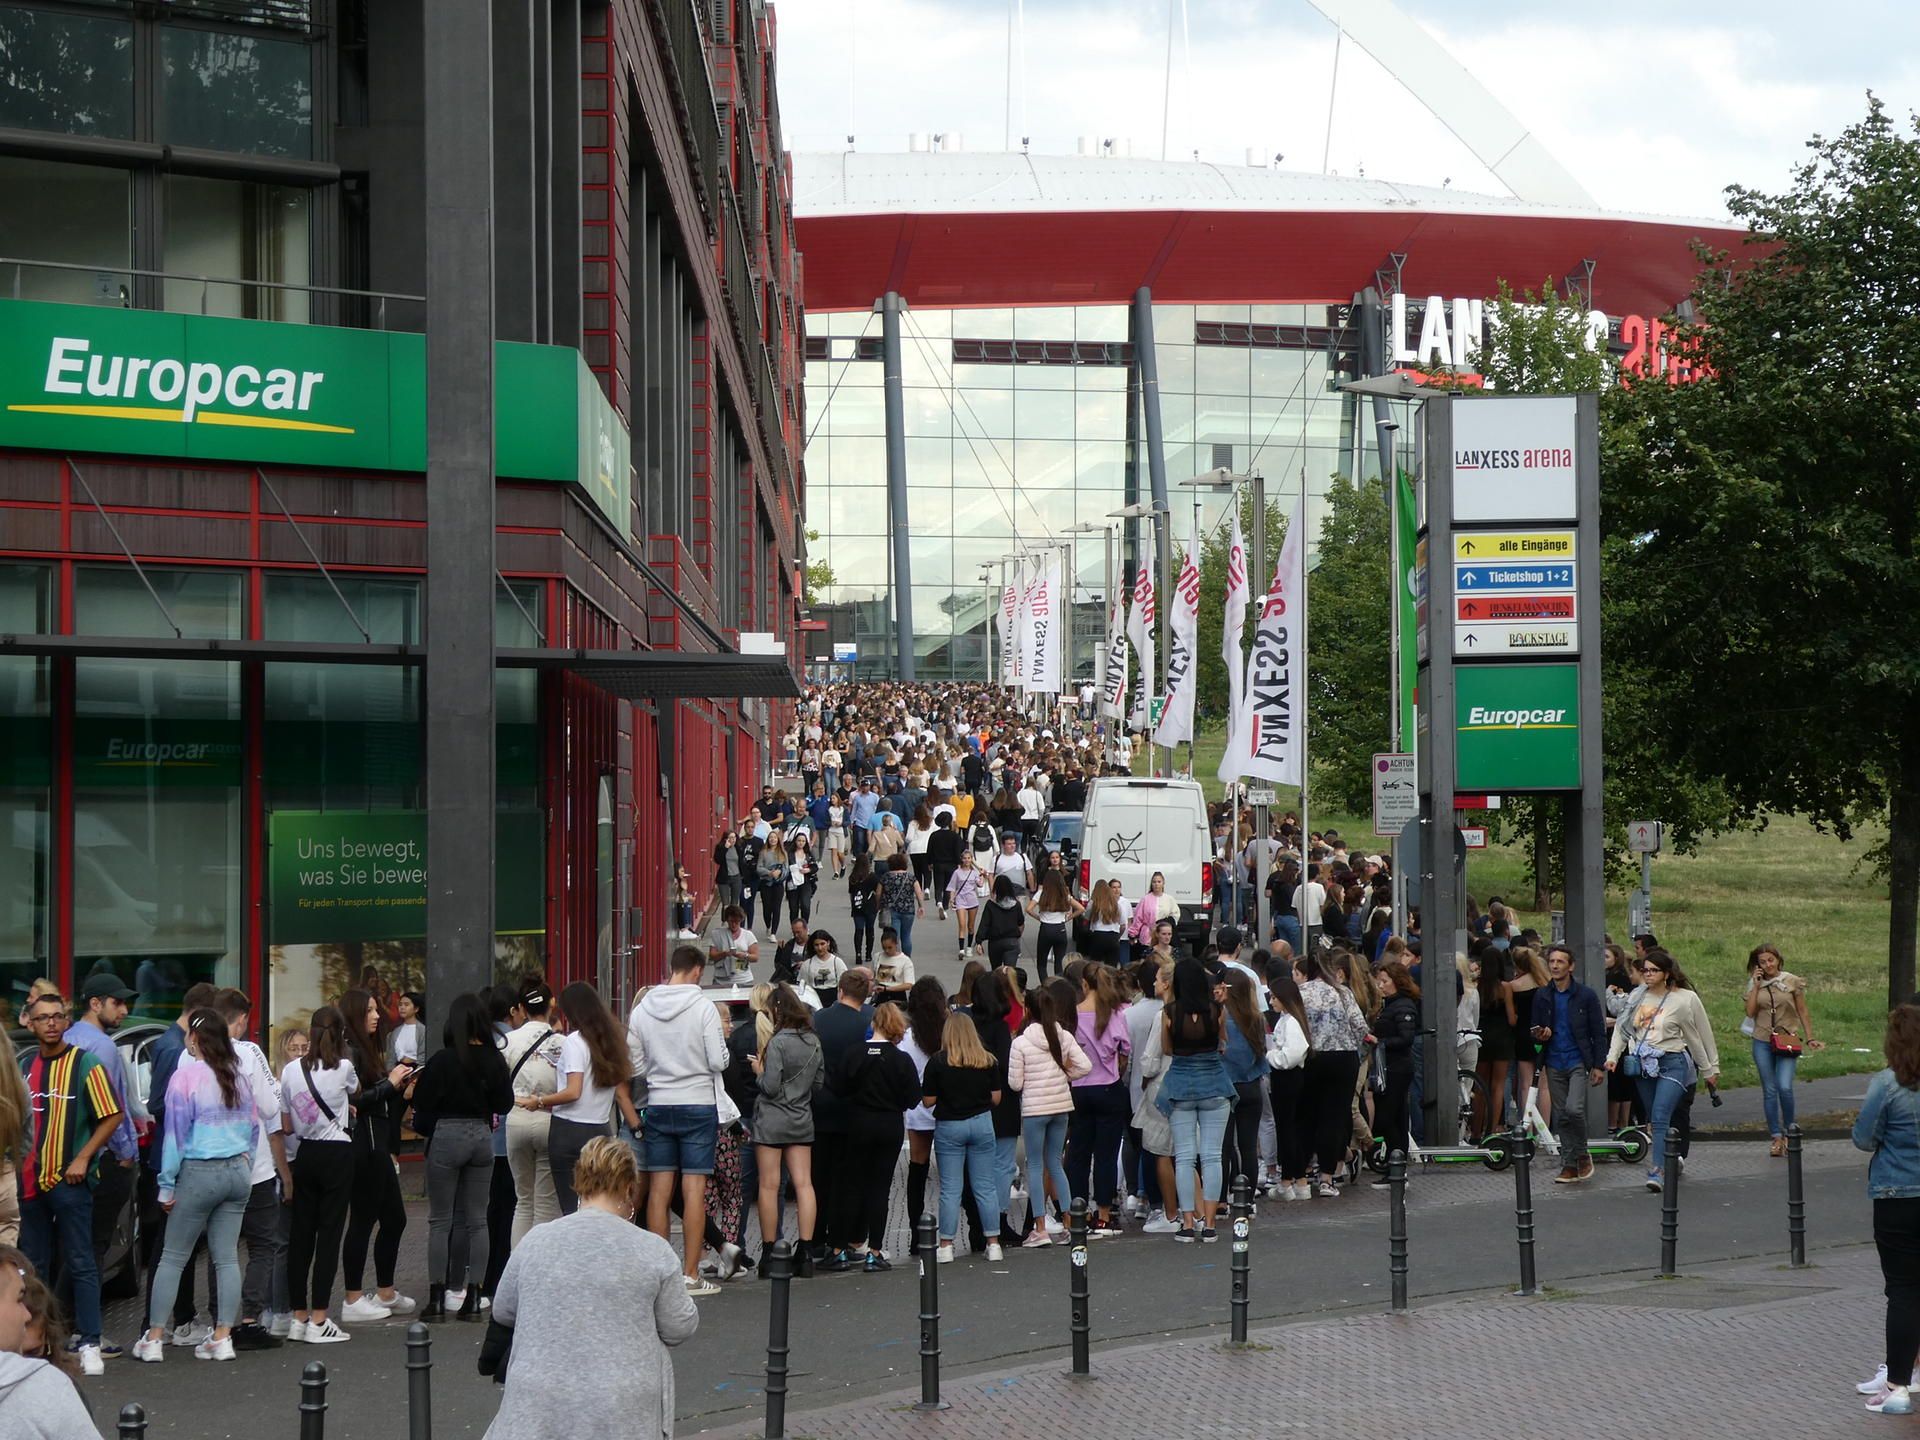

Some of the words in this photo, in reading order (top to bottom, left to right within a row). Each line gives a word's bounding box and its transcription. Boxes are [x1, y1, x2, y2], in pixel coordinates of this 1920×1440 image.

[45, 337, 324, 422] Europcar
[1455, 450, 1519, 469] LANXESS
[1523, 448, 1572, 468] arena
[1499, 540, 1518, 551] alle
[1521, 539, 1568, 551] Eingänge
[1488, 571, 1543, 583] Ticketshop
[1546, 570, 1552, 582] 1
[1561, 569, 1569, 582] 2
[1469, 707, 1566, 728] Europcar
[106, 738, 209, 765] Europcar
[298, 837, 335, 858] Uns
[341, 836, 420, 863] bewegt,
[299, 870, 334, 885] was
[340, 863, 367, 884] Sie
[298, 898, 311, 908] Für
[313, 899, 335, 909] jeden
[338, 898, 372, 907] Transport
[375, 896, 389, 905] den
[391, 896, 426, 905] passende
